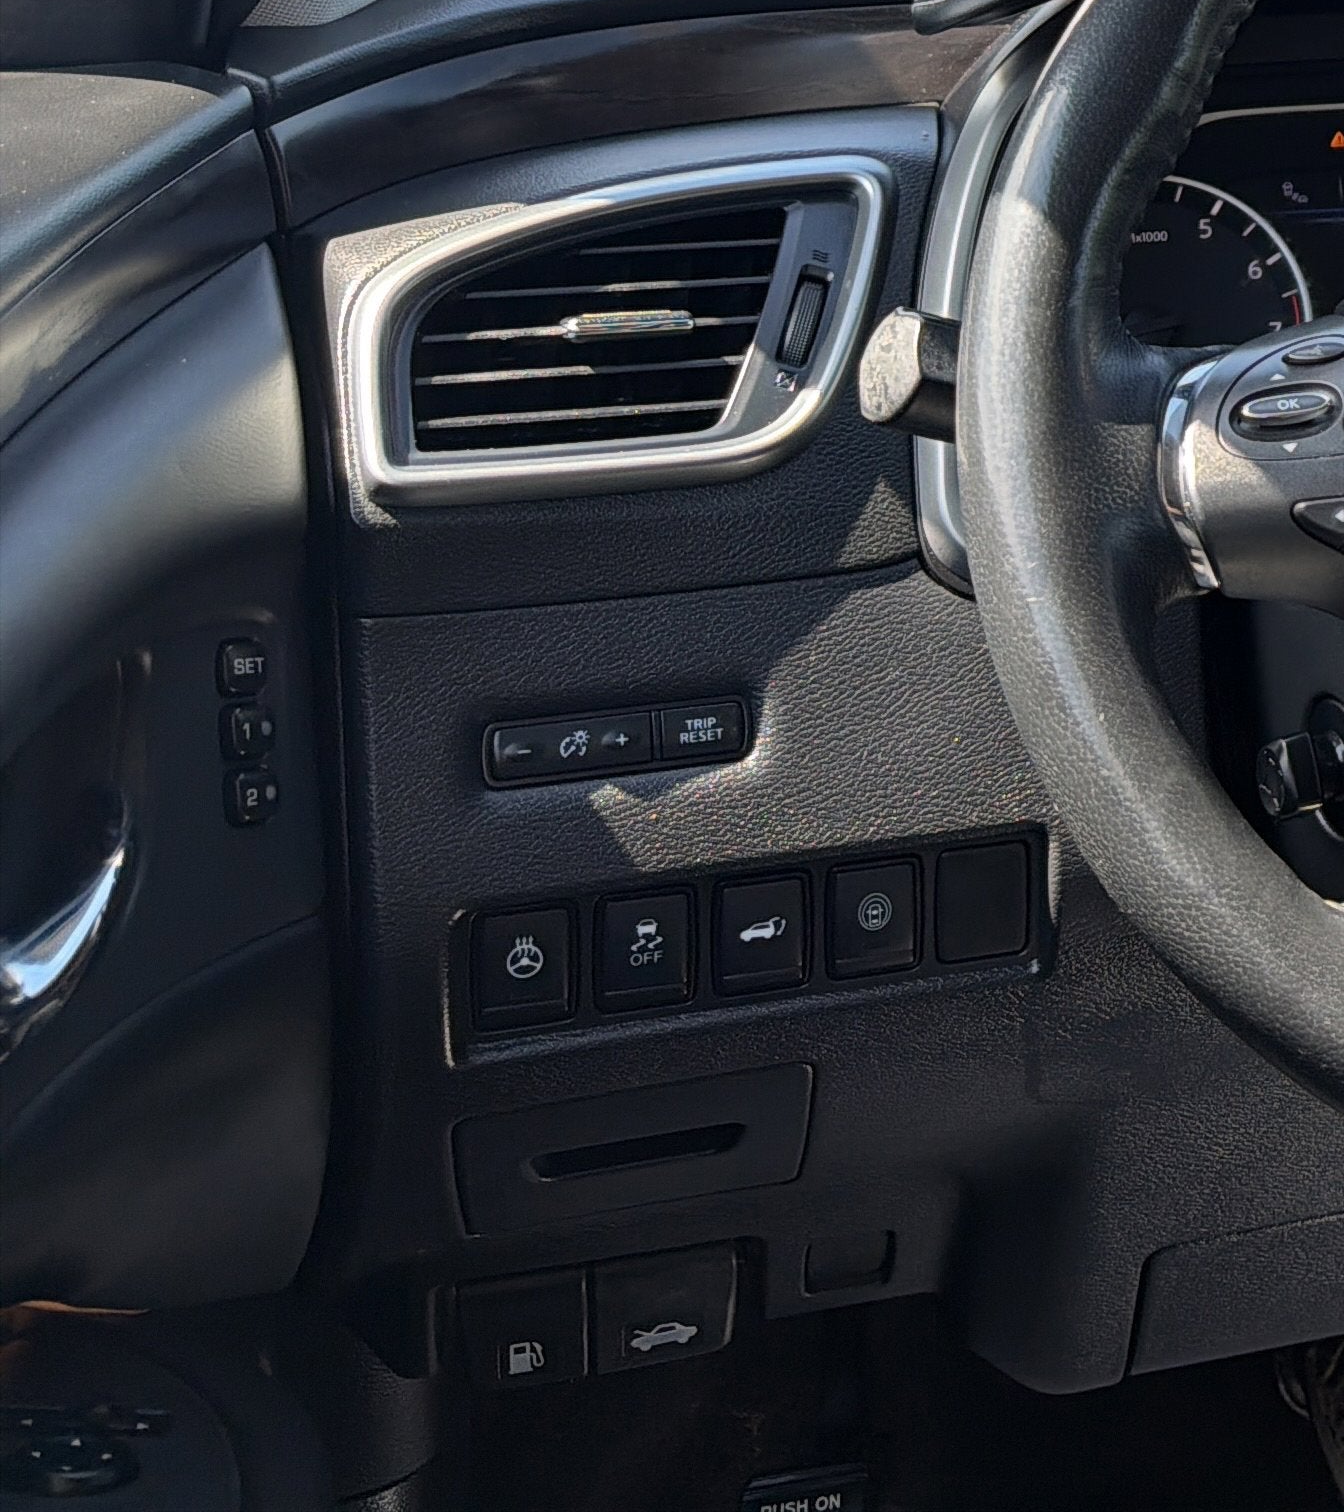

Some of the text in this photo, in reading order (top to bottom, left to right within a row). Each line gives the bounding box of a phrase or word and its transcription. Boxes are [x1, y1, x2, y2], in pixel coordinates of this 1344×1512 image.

[1198, 219, 1213, 239] 5
[1248, 261, 1263, 280] 6
[1276, 398, 1301, 411] OK
[233, 657, 265, 676] SET
[242, 723, 251, 740] 1
[685, 717, 717, 732] TRIP
[679, 727, 723, 745] RESET
[246, 789, 259, 806] 2
[629, 949, 664, 968] OFF
[815, 1493, 841, 1511] ON
